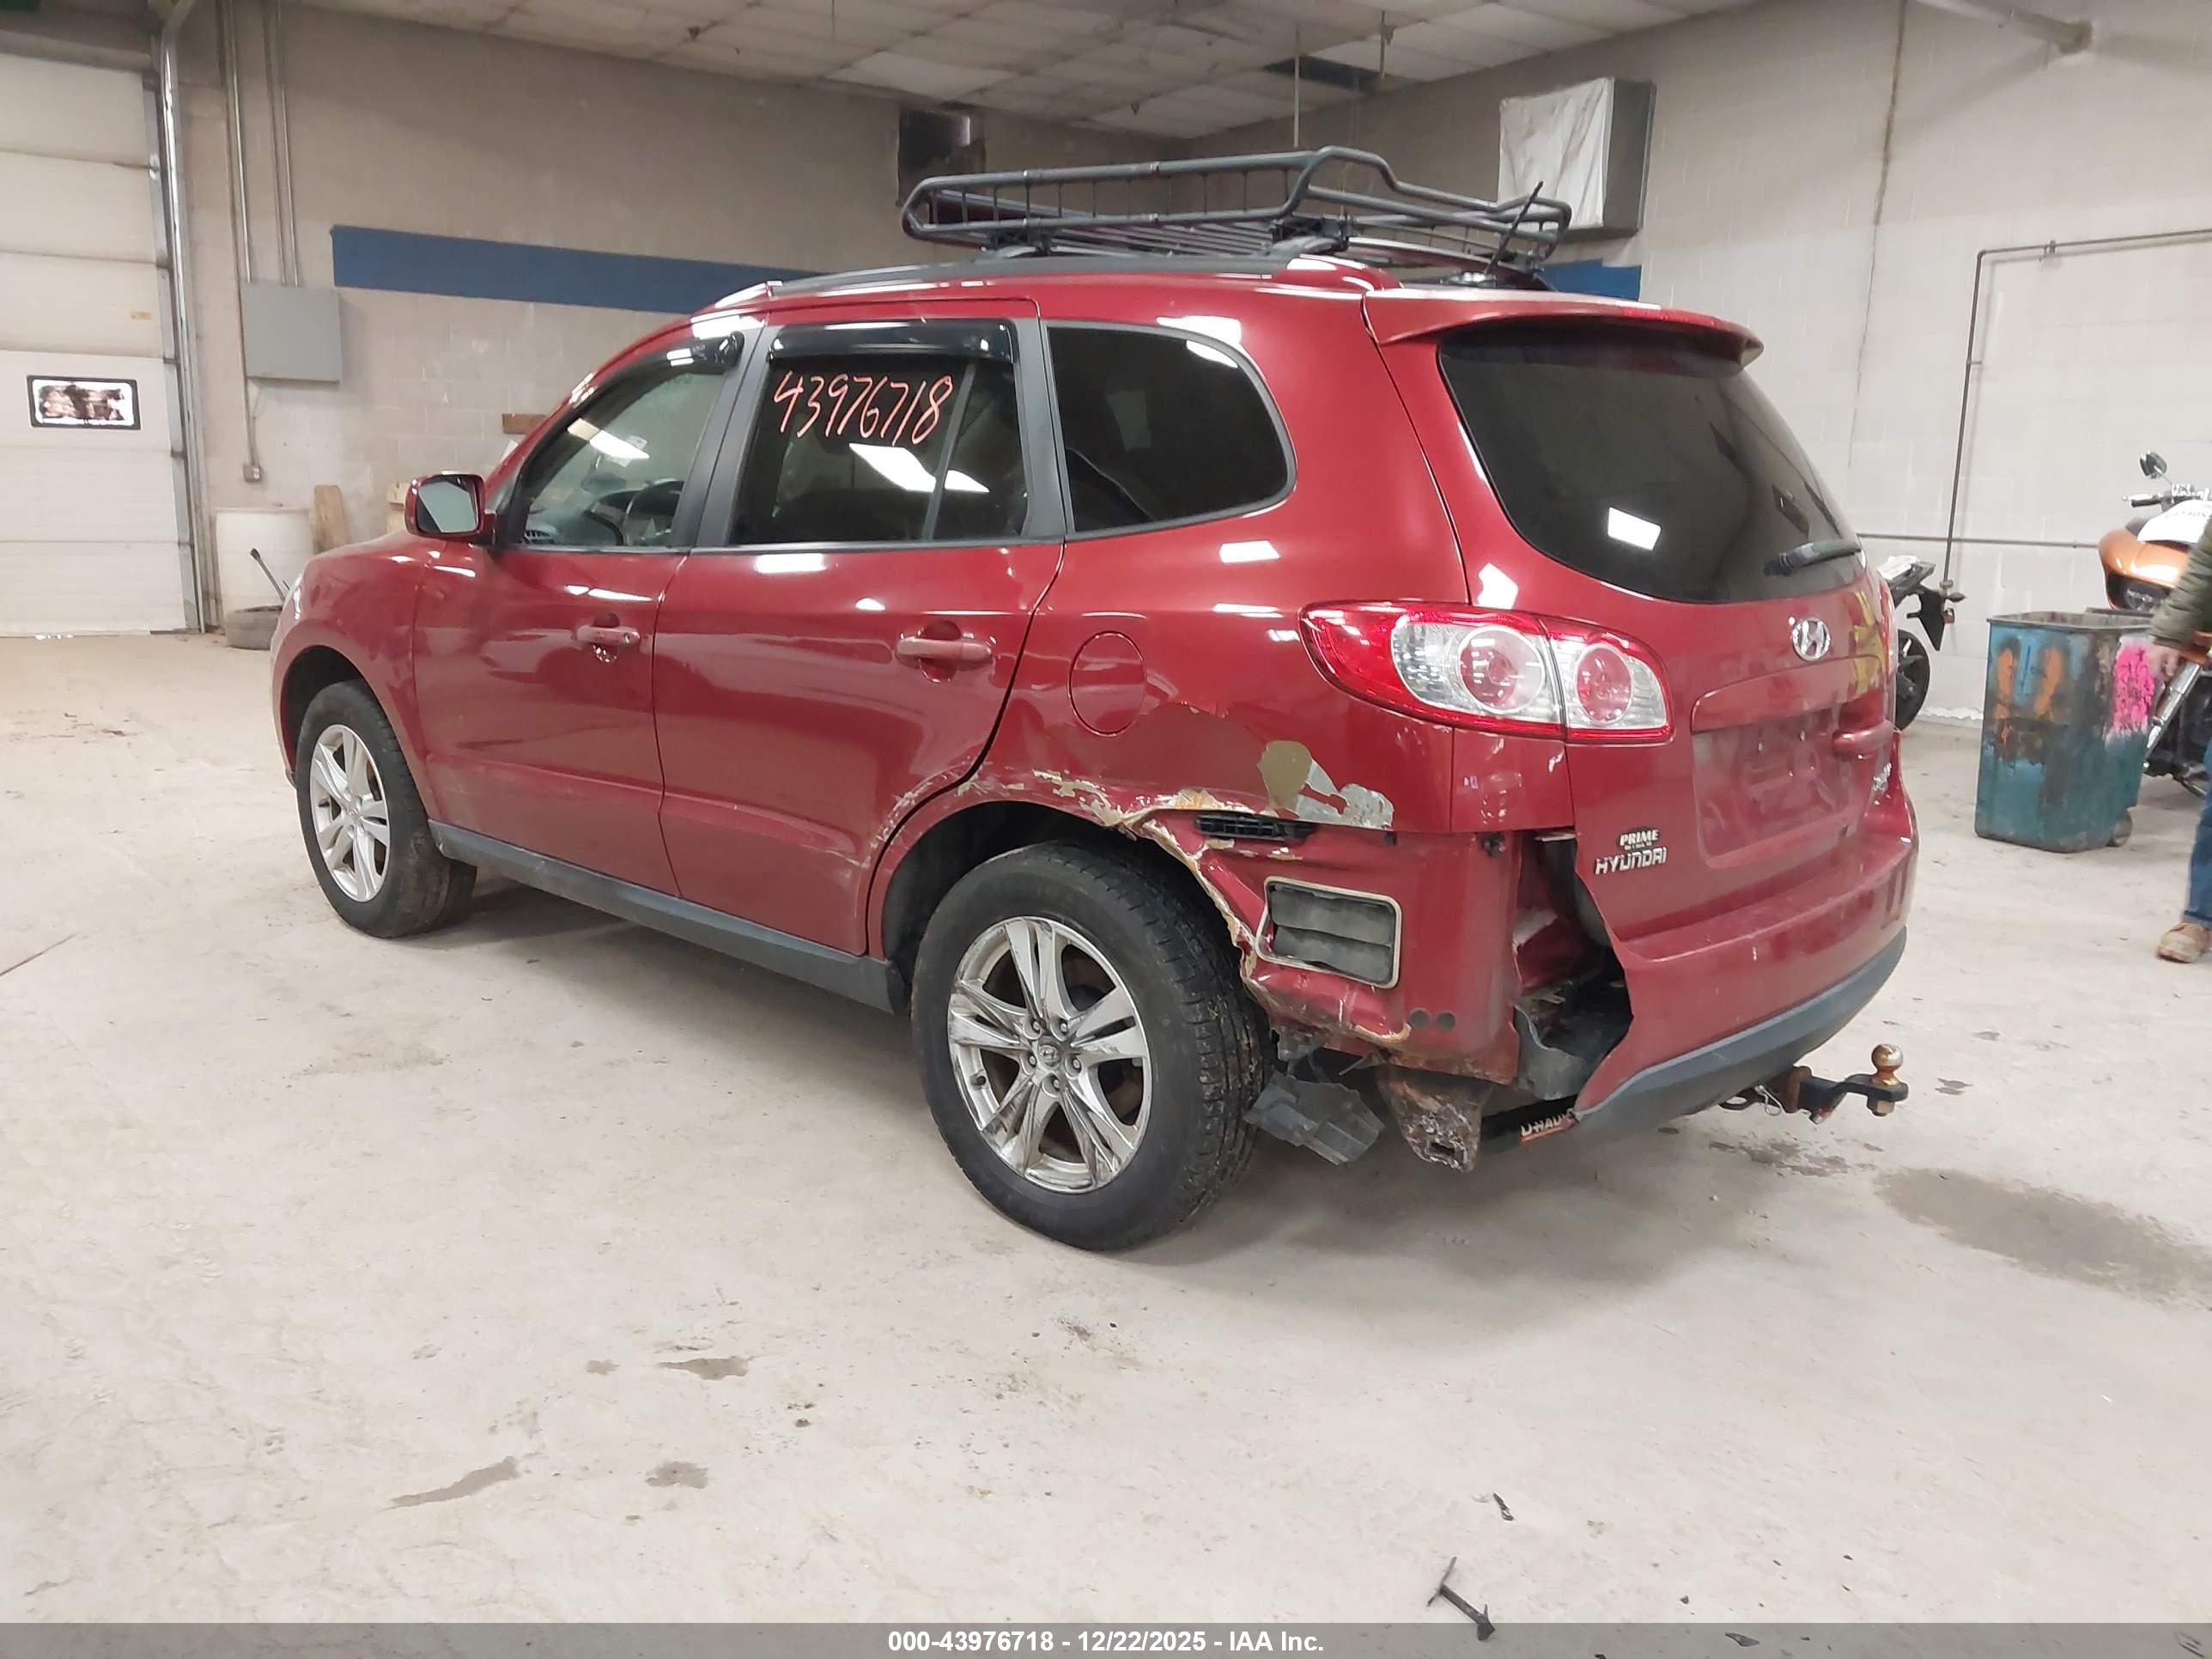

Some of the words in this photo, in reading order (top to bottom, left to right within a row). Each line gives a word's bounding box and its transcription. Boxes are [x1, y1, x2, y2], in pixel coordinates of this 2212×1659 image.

[774, 370, 953, 446] 43976718
[1620, 829, 1660, 847] PRIME
[1595, 846, 1668, 875] HYUNDAI
